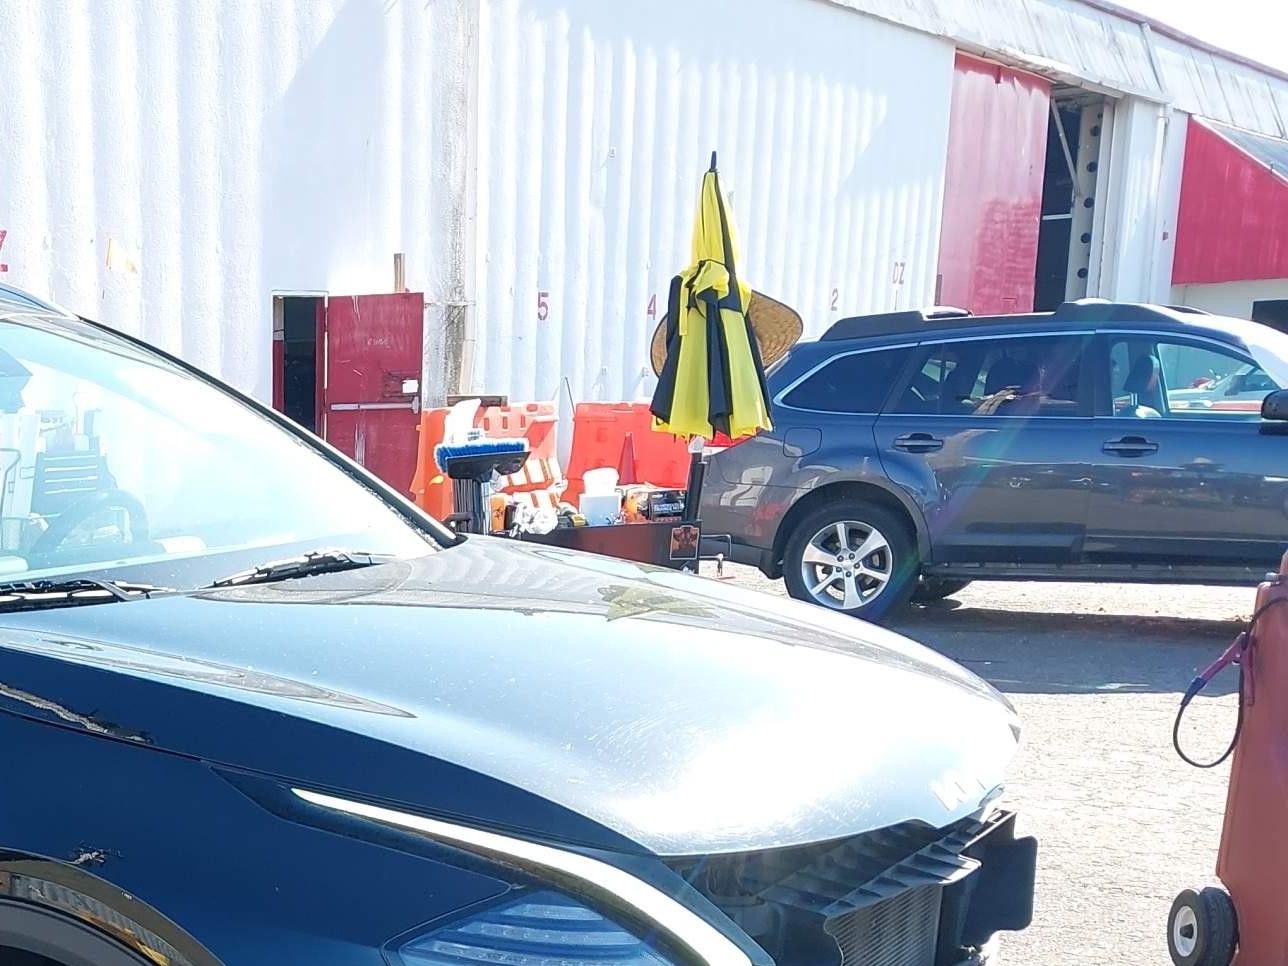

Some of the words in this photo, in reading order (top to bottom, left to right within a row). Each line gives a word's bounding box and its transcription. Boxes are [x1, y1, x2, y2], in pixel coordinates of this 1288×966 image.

[537, 291, 549, 321] 5
[647, 293, 657, 321] 4
[830, 287, 839, 311] 2
